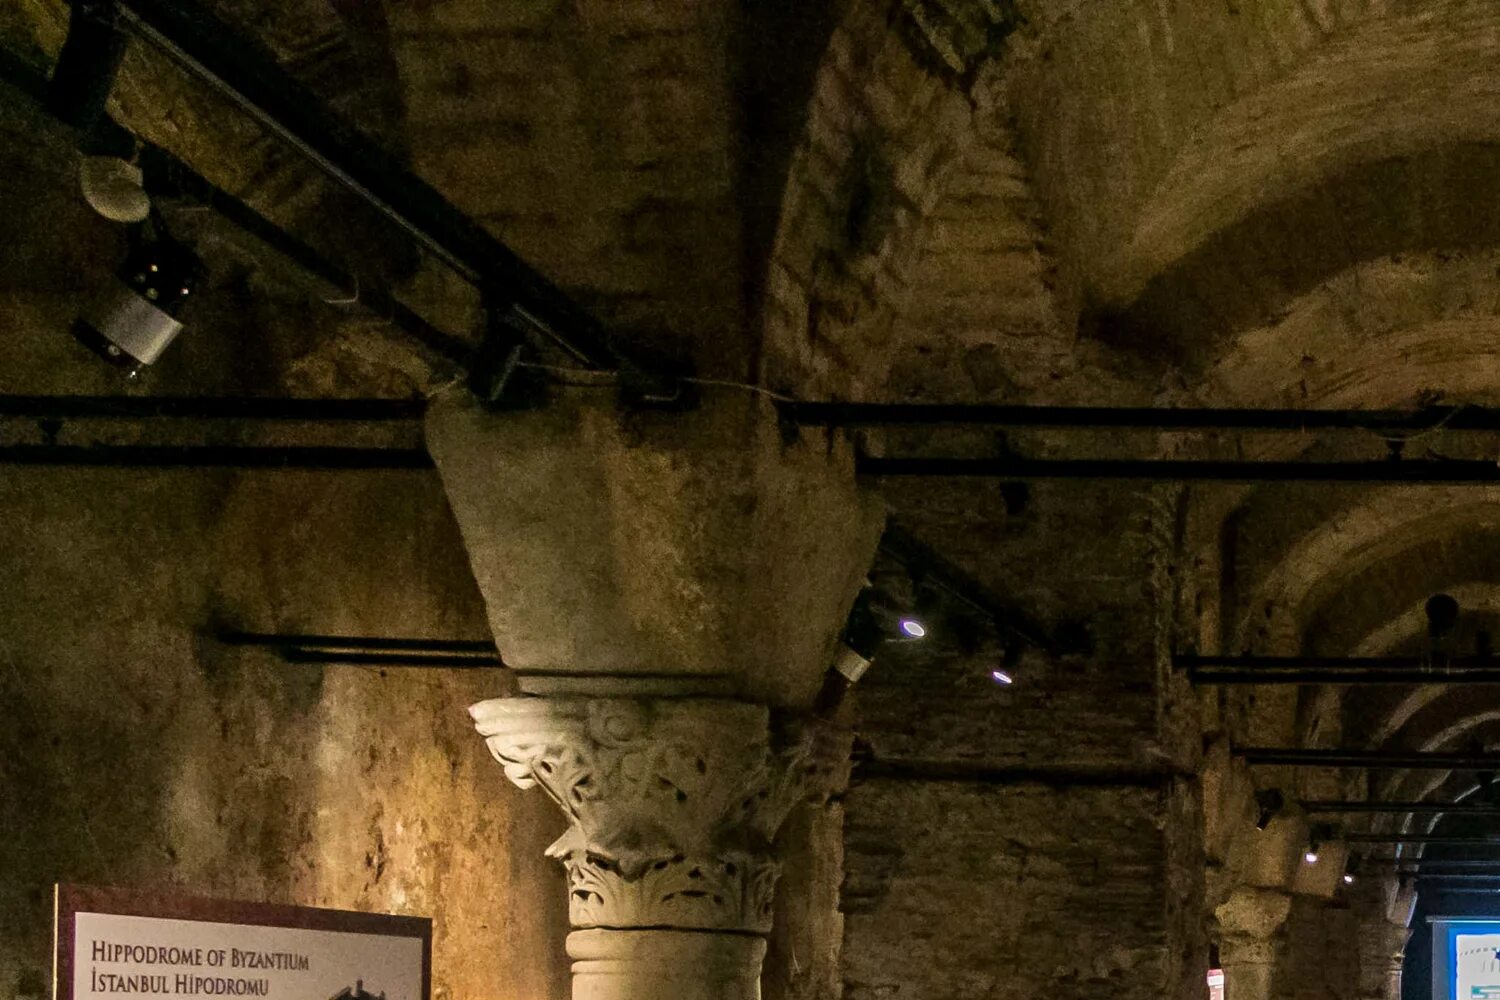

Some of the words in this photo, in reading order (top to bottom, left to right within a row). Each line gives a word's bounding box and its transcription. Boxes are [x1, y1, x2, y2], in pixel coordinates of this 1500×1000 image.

[91, 940, 203, 966] HIPPODROME
[206, 949, 226, 967] OF
[231, 948, 309, 971] BYZANTIUM
[91, 966, 170, 993] İSTANBUL
